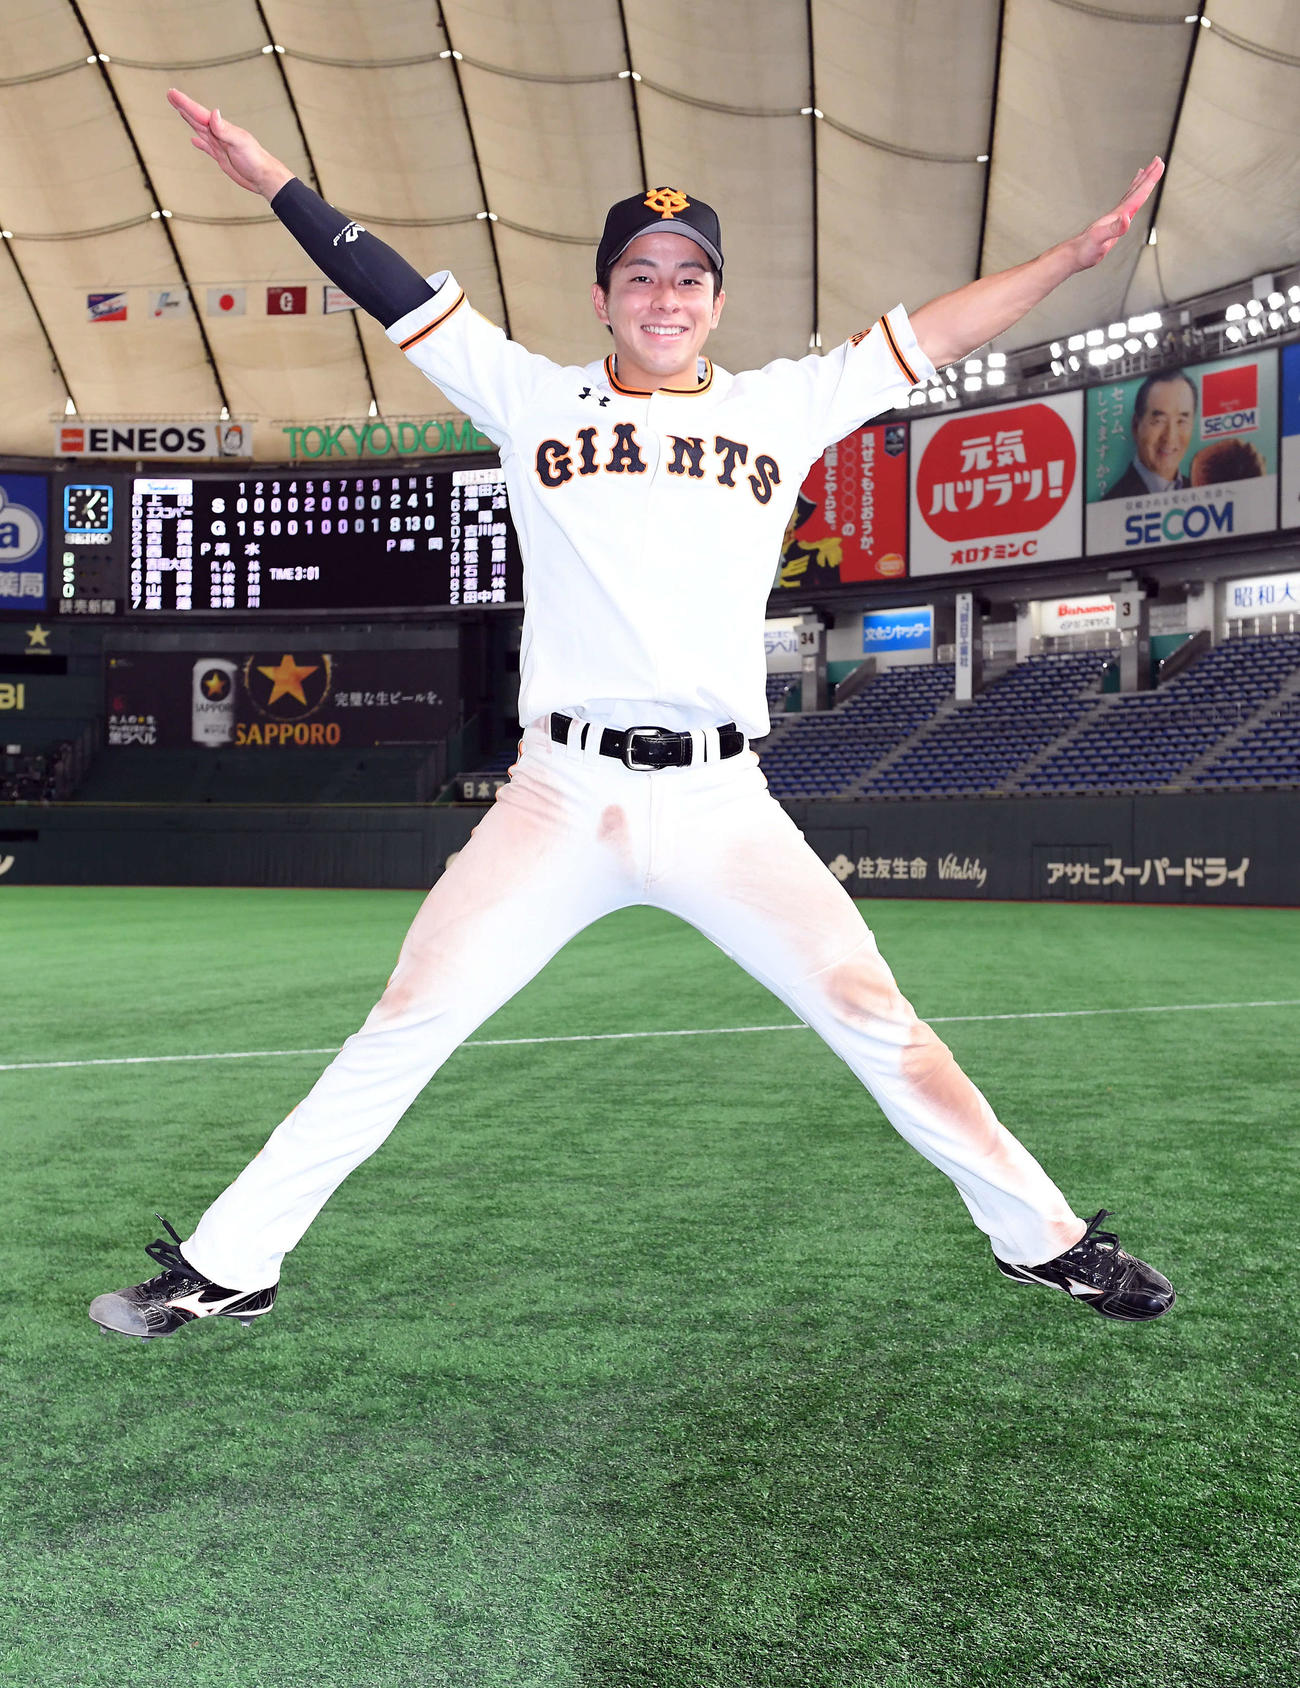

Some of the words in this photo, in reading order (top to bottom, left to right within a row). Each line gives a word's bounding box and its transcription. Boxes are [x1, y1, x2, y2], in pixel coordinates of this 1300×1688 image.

[1204, 411, 1255, 434] SECOM
[89, 428, 206, 453] ENEOS
[282, 423, 392, 458] TOKYO
[397, 420, 492, 454] DOME
[960, 429, 1027, 473] 元気
[535, 422, 781, 505] GIANTS
[239, 483, 245, 494] 1
[256, 482, 263, 495] 2
[273, 482, 280, 494] 3
[289, 482, 297, 493] 4
[306, 481, 314, 493] 5
[323, 481, 330, 493] 6
[340, 480, 347, 491] 7
[373, 479, 380, 491] 9
[426, 476, 433, 489] E
[450, 486, 460, 498] 4
[928, 459, 1065, 516] ハツラツ!
[211, 498, 225, 513] S
[237, 498, 247, 513] 0
[254, 498, 264, 513] 0
[271, 498, 281, 513] 0
[288, 498, 298, 513] 0
[304, 497, 315, 512] 2
[321, 497, 331, 511] 0
[338, 496, 348, 511] 0
[355, 496, 364, 510] 0
[371, 495, 380, 510] 0
[390, 494, 401, 509] 2
[407, 493, 418, 508] 4
[425, 493, 433, 507] 1
[450, 499, 460, 512] 6
[132, 507, 142, 519] D
[450, 512, 460, 525] 3
[132, 519, 142, 532] 5
[211, 520, 226, 536] G
[237, 521, 246, 536] 1
[254, 521, 264, 536] 5
[271, 520, 281, 535] 0
[288, 520, 298, 535] 0
[305, 520, 313, 534] 1
[321, 519, 331, 534] 0
[338, 519, 348, 533] 0
[355, 518, 364, 533] 0
[371, 518, 379, 532] 1
[390, 517, 400, 532] 8
[405, 516, 420, 531] 13
[425, 515, 434, 530] 0
[1125, 501, 1234, 546] SECOM
[64, 533, 112, 545] SEIKO
[132, 532, 142, 544] 2
[450, 525, 460, 538] D
[200, 542, 211, 556] P
[386, 539, 396, 552] P
[450, 538, 460, 552] 7
[63, 552, 75, 567] B
[450, 551, 460, 565] 9
[951, 540, 1038, 566] オロナミンC
[131, 558, 141, 570] 4
[450, 565, 460, 578] H
[464, 563, 506, 578] 石川
[63, 567, 75, 583] S
[131, 571, 141, 583] 6
[294, 566, 320, 581] 3:01
[131, 583, 141, 596] 9
[450, 578, 460, 591] 8
[131, 597, 141, 609] 7
[450, 591, 460, 604] 2
[59, 599, 116, 615] 読売新聞
[1122, 602, 1131, 616] 3
[801, 632, 815, 645] 34
[864, 623, 931, 642] 文化シャッター
[334, 691, 443, 708] 完璧な生ビールを。
[234, 723, 341, 746] SAPPORO
[857, 856, 928, 880] 住友生命
[938, 852, 987, 888] Vitality
[1046, 857, 1250, 888] アサヒスーパードライ
